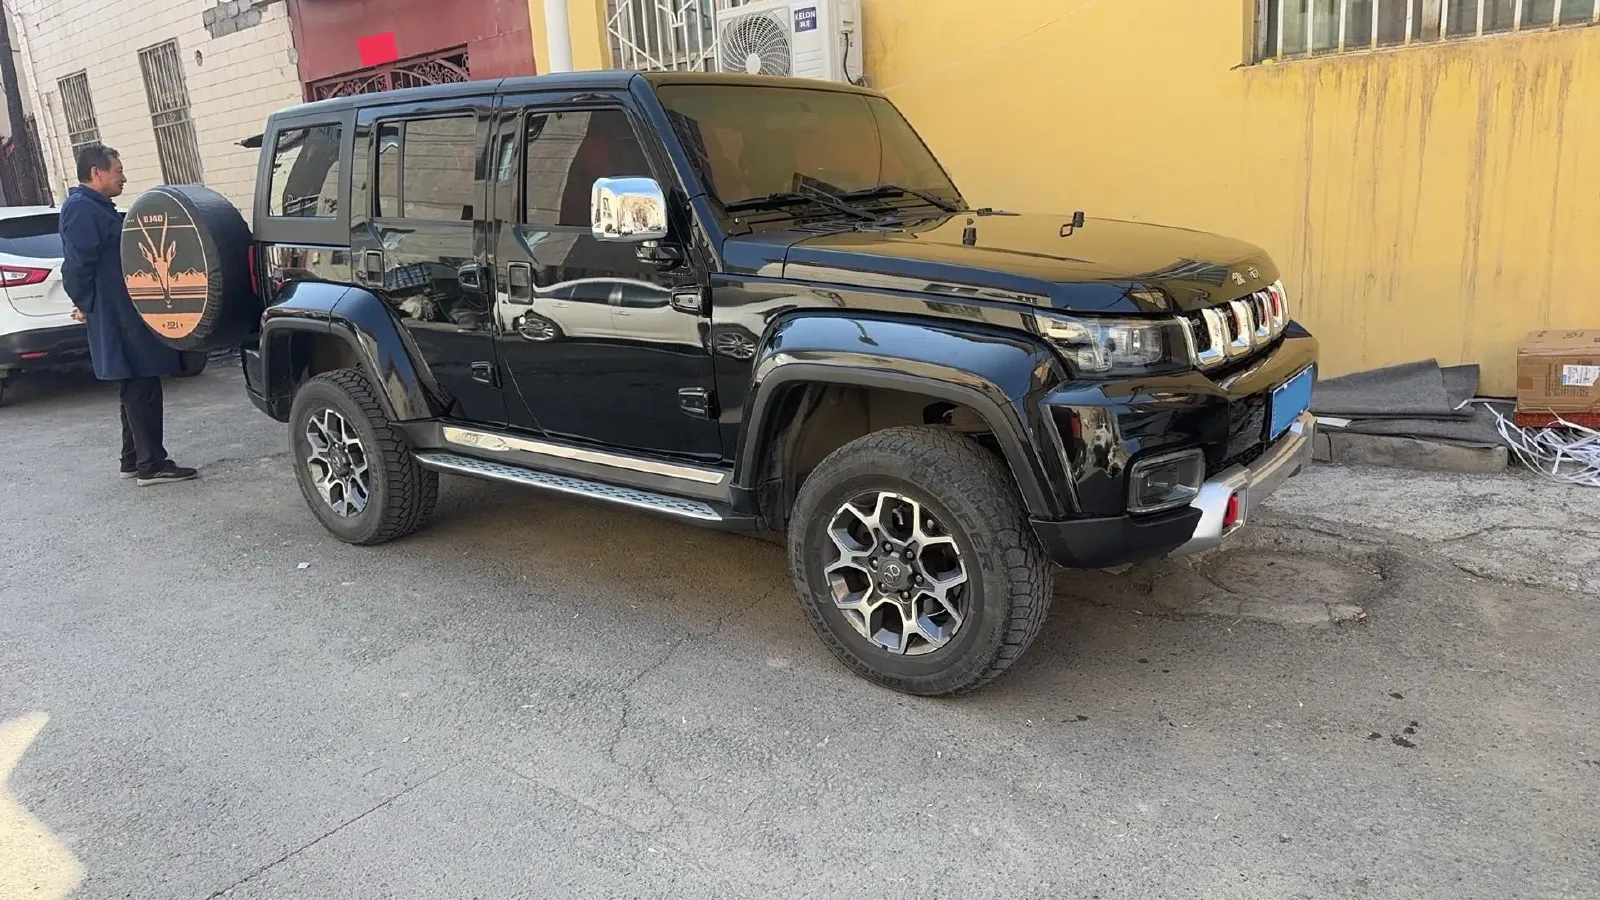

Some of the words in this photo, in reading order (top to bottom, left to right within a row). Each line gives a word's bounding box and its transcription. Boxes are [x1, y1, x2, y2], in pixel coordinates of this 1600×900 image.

[795, 10, 815, 20] KELON
[143, 214, 163, 223] BJ40
[909, 460, 995, 573] COOPER
